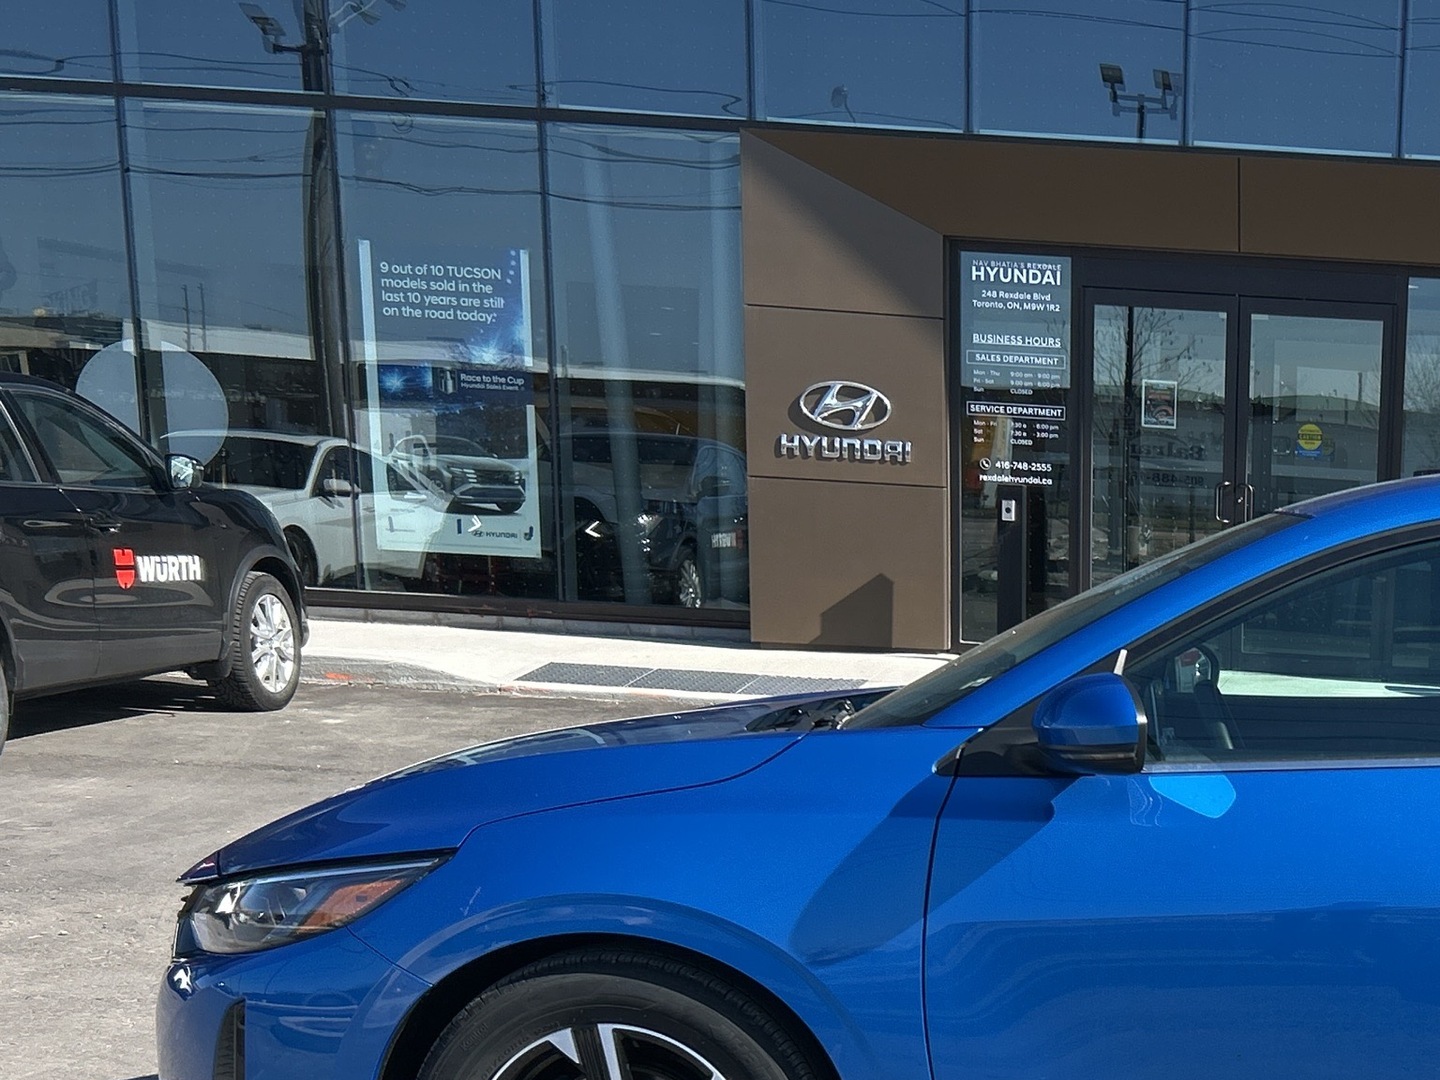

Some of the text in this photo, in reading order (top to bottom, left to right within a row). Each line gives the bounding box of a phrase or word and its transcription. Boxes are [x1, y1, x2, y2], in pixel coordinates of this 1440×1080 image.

[380, 261, 501, 280] 9 out of 10 TUCSON
[990, 261, 1025, 269] BHATIA'S
[1026, 262, 1061, 271] REXDALE
[971, 266, 1061, 286] HYUNDAI
[381, 277, 493, 294] models sold in the
[381, 290, 505, 308] last 10 years are still
[999, 291, 1031, 300] Rexdale
[1033, 292, 1051, 301] Blvd
[972, 300, 1060, 312] Toronto, ON, M9W 1R2
[382, 306, 399, 316] on
[401, 306, 422, 317] the
[425, 308, 454, 320] road
[972, 333, 1061, 347] BUSINESS HOURS
[975, 354, 1059, 365] SALES DEPARTMENT
[460, 373, 481, 381] Race
[492, 375, 506, 384] the
[507, 376, 524, 385] Cup
[970, 404, 1062, 417] SERVICE DEPARTMENT
[780, 433, 912, 463] HYUNDAI
[995, 460, 1052, 472] 416-748-2555
